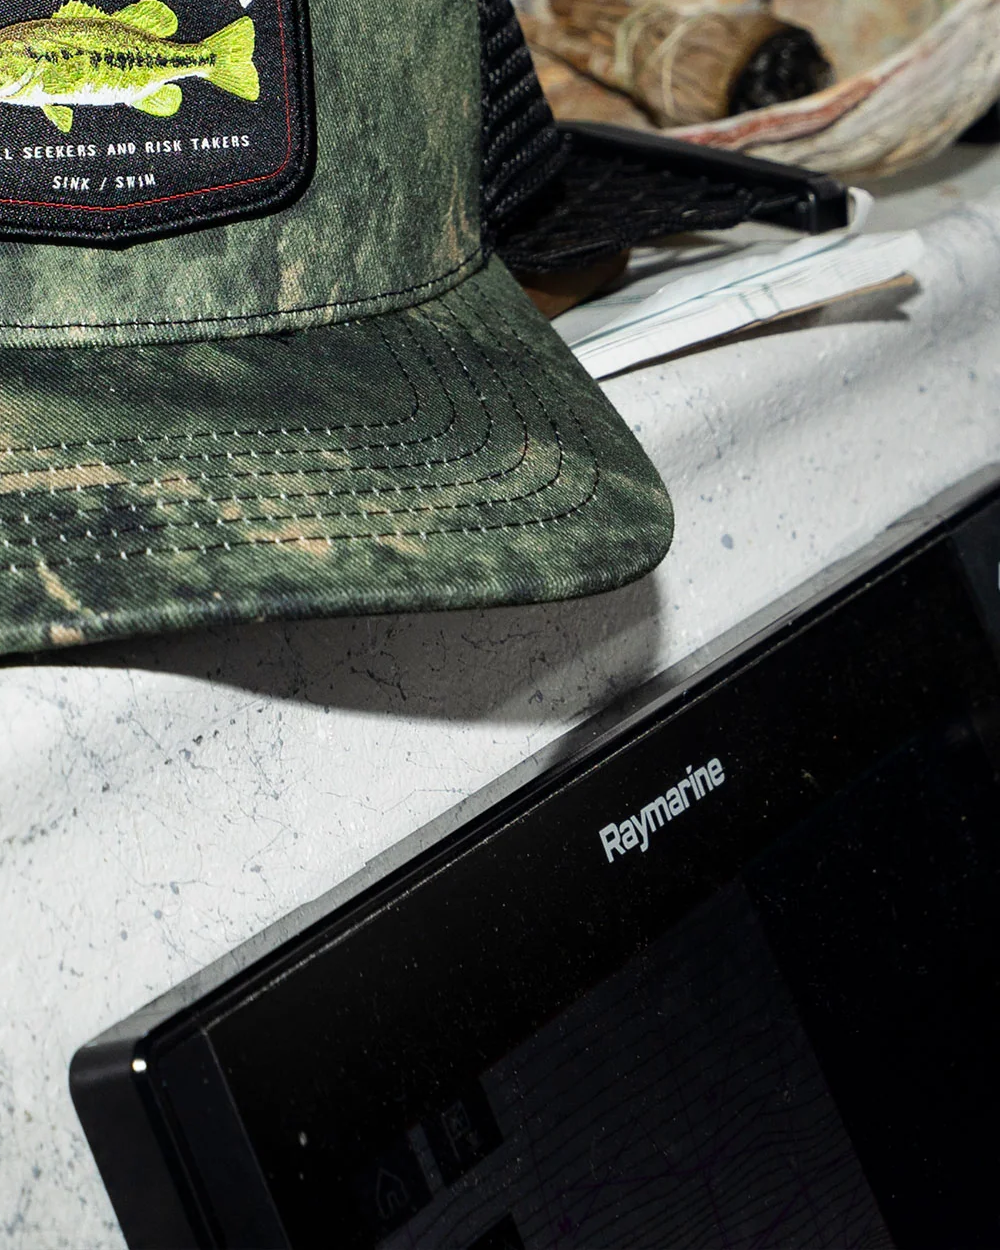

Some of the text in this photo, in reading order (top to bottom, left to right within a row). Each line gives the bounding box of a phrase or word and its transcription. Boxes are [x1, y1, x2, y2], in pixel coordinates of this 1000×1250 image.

[22, 144, 97, 159] SEEKERS
[107, 142, 136, 156] AND
[145, 139, 182, 154] RISK
[190, 134, 250, 150] TAKERS
[52, 175, 90, 190] SINK
[115, 173, 156, 188] SWIM
[598, 757, 726, 864] Raymarine
